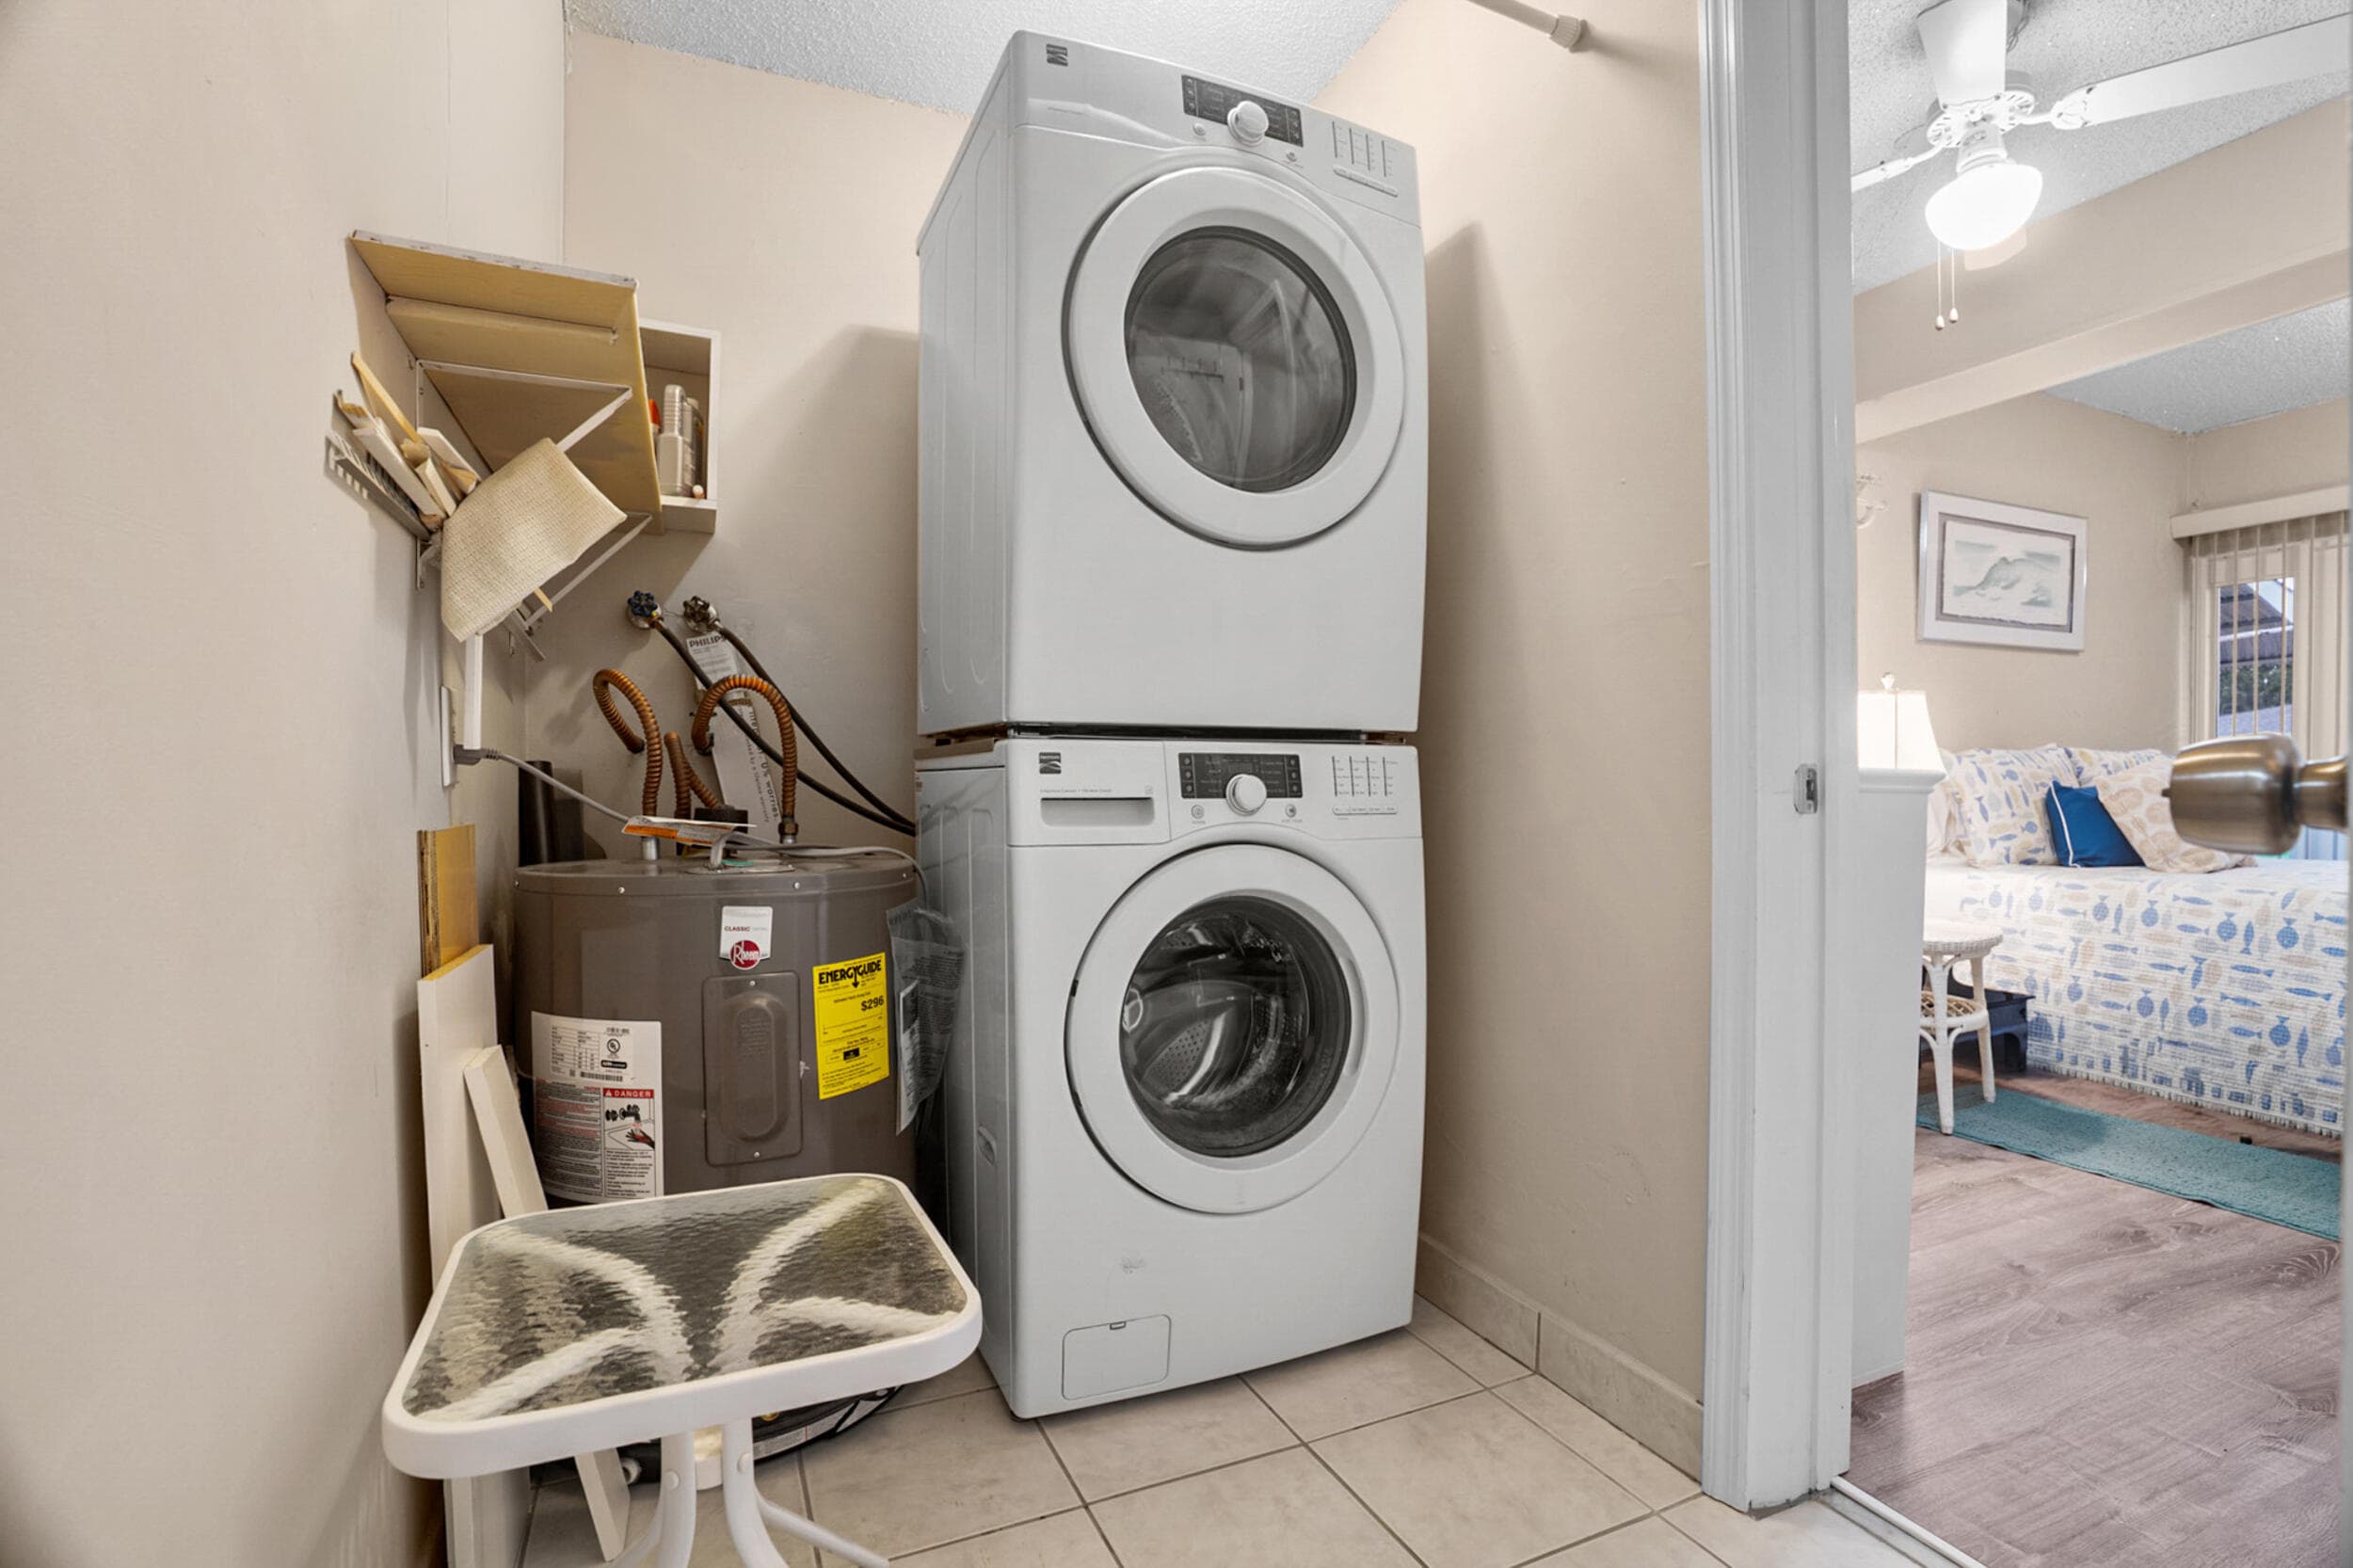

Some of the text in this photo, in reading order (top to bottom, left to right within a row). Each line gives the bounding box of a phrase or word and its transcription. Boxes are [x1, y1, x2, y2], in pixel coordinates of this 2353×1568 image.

[688, 634, 725, 648] PHILIPS
[733, 941, 760, 965] Rheem
[861, 996, 884, 1011] $296
